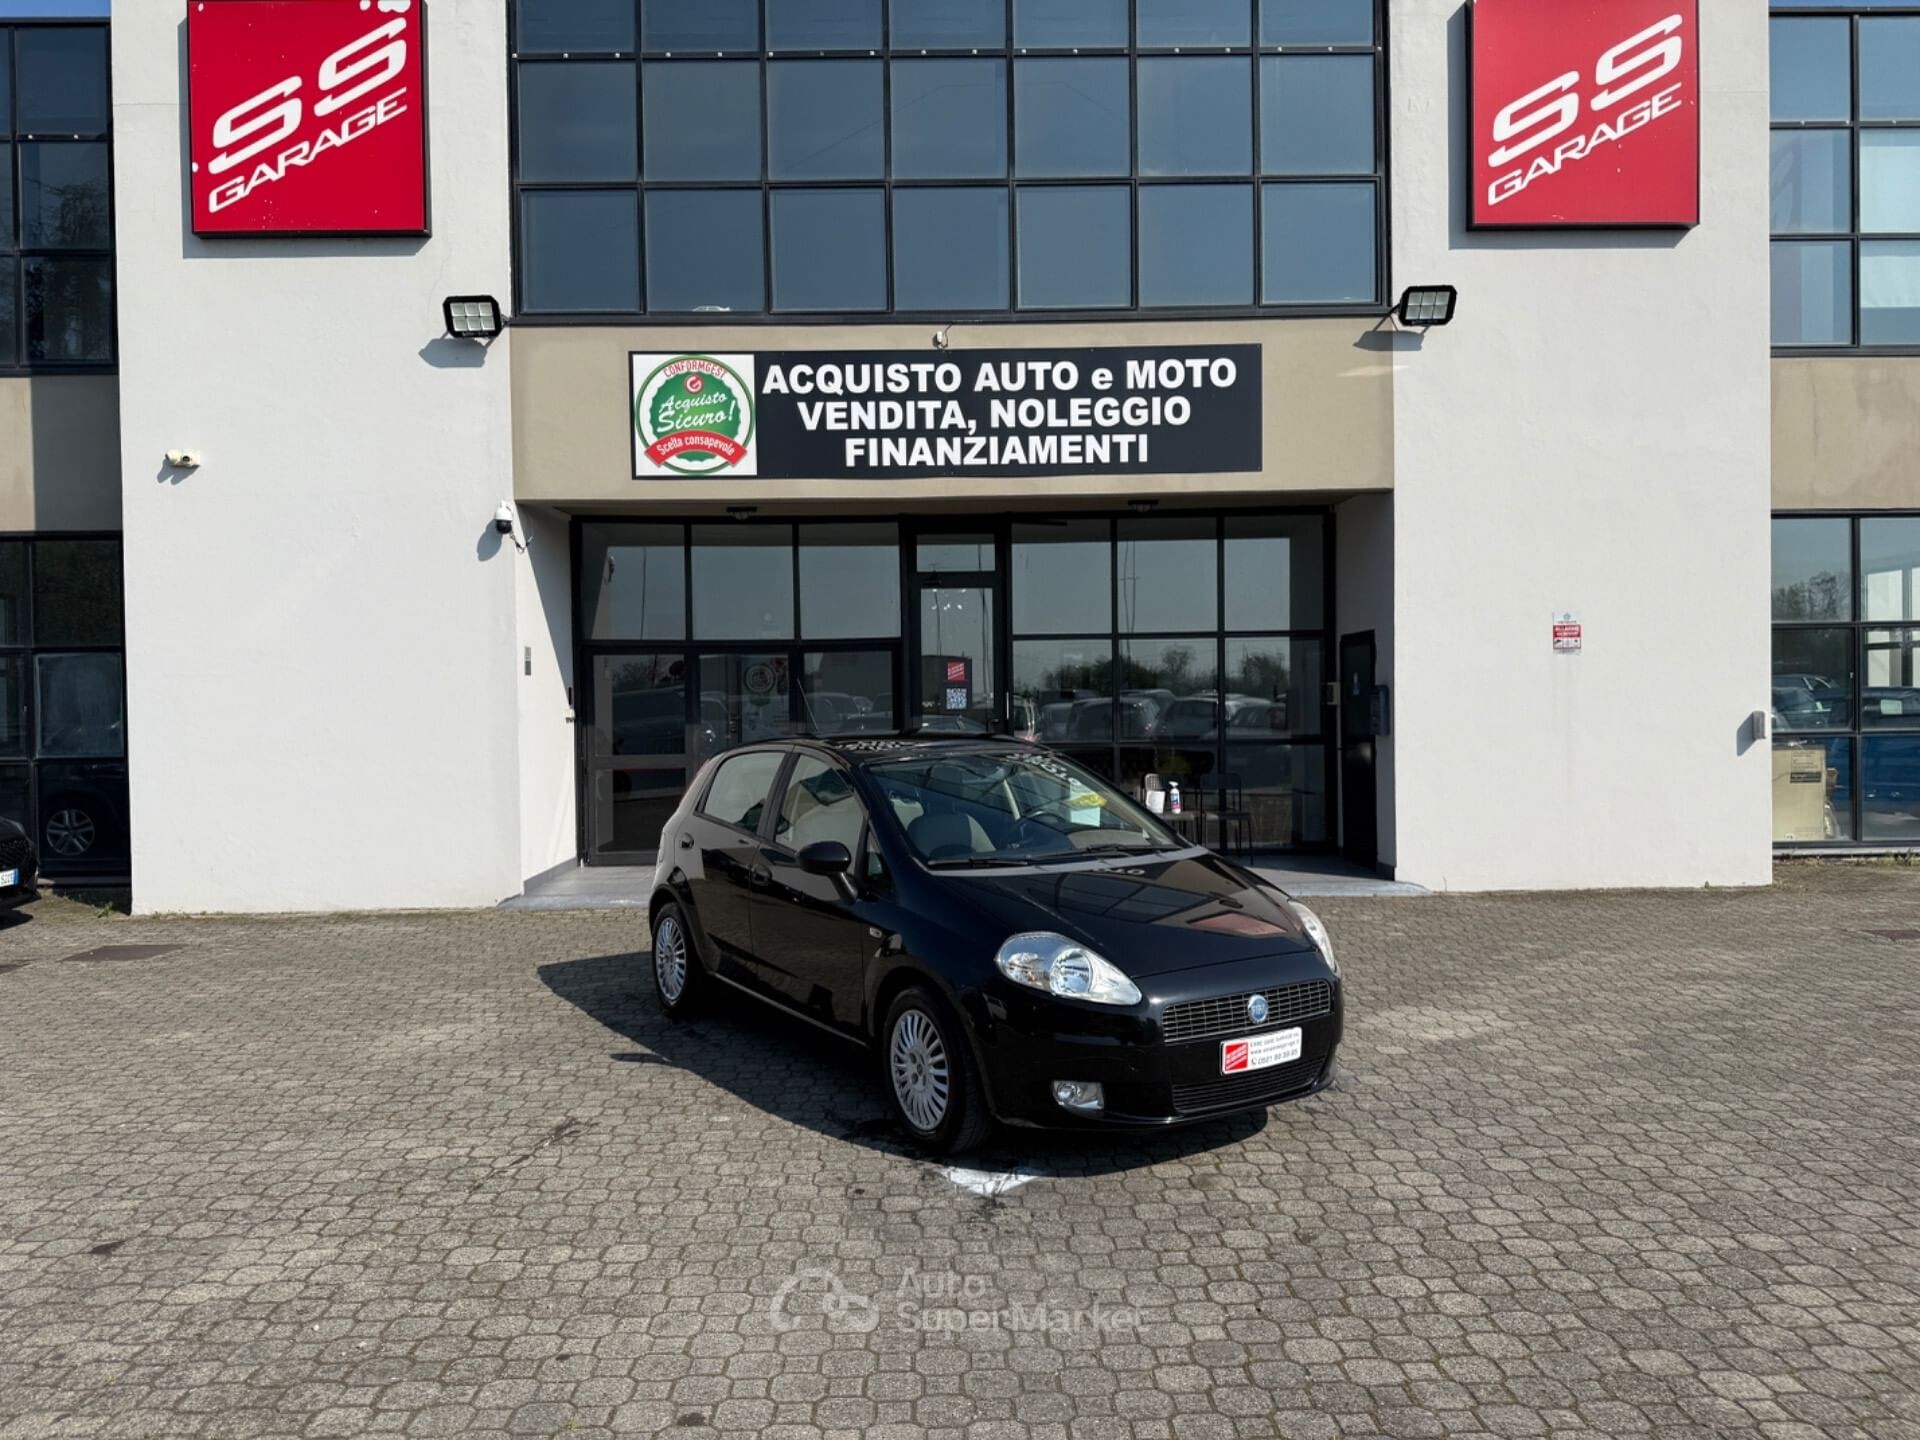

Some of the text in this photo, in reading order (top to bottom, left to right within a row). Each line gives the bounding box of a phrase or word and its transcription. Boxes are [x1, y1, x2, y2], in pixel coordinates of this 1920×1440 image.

[209, 86, 408, 213] GARAGE
[1488, 82, 1682, 206] GARAGE
[762, 357, 1237, 396] ACQUISTO AUTO e MOTO
[658, 391, 728, 413] Acquisto
[797, 395, 1191, 435] VENDITA, NOLEGGIO
[656, 435, 735, 456] Scelta consapevole
[845, 433, 1148, 467] FINANZIAMENTI
